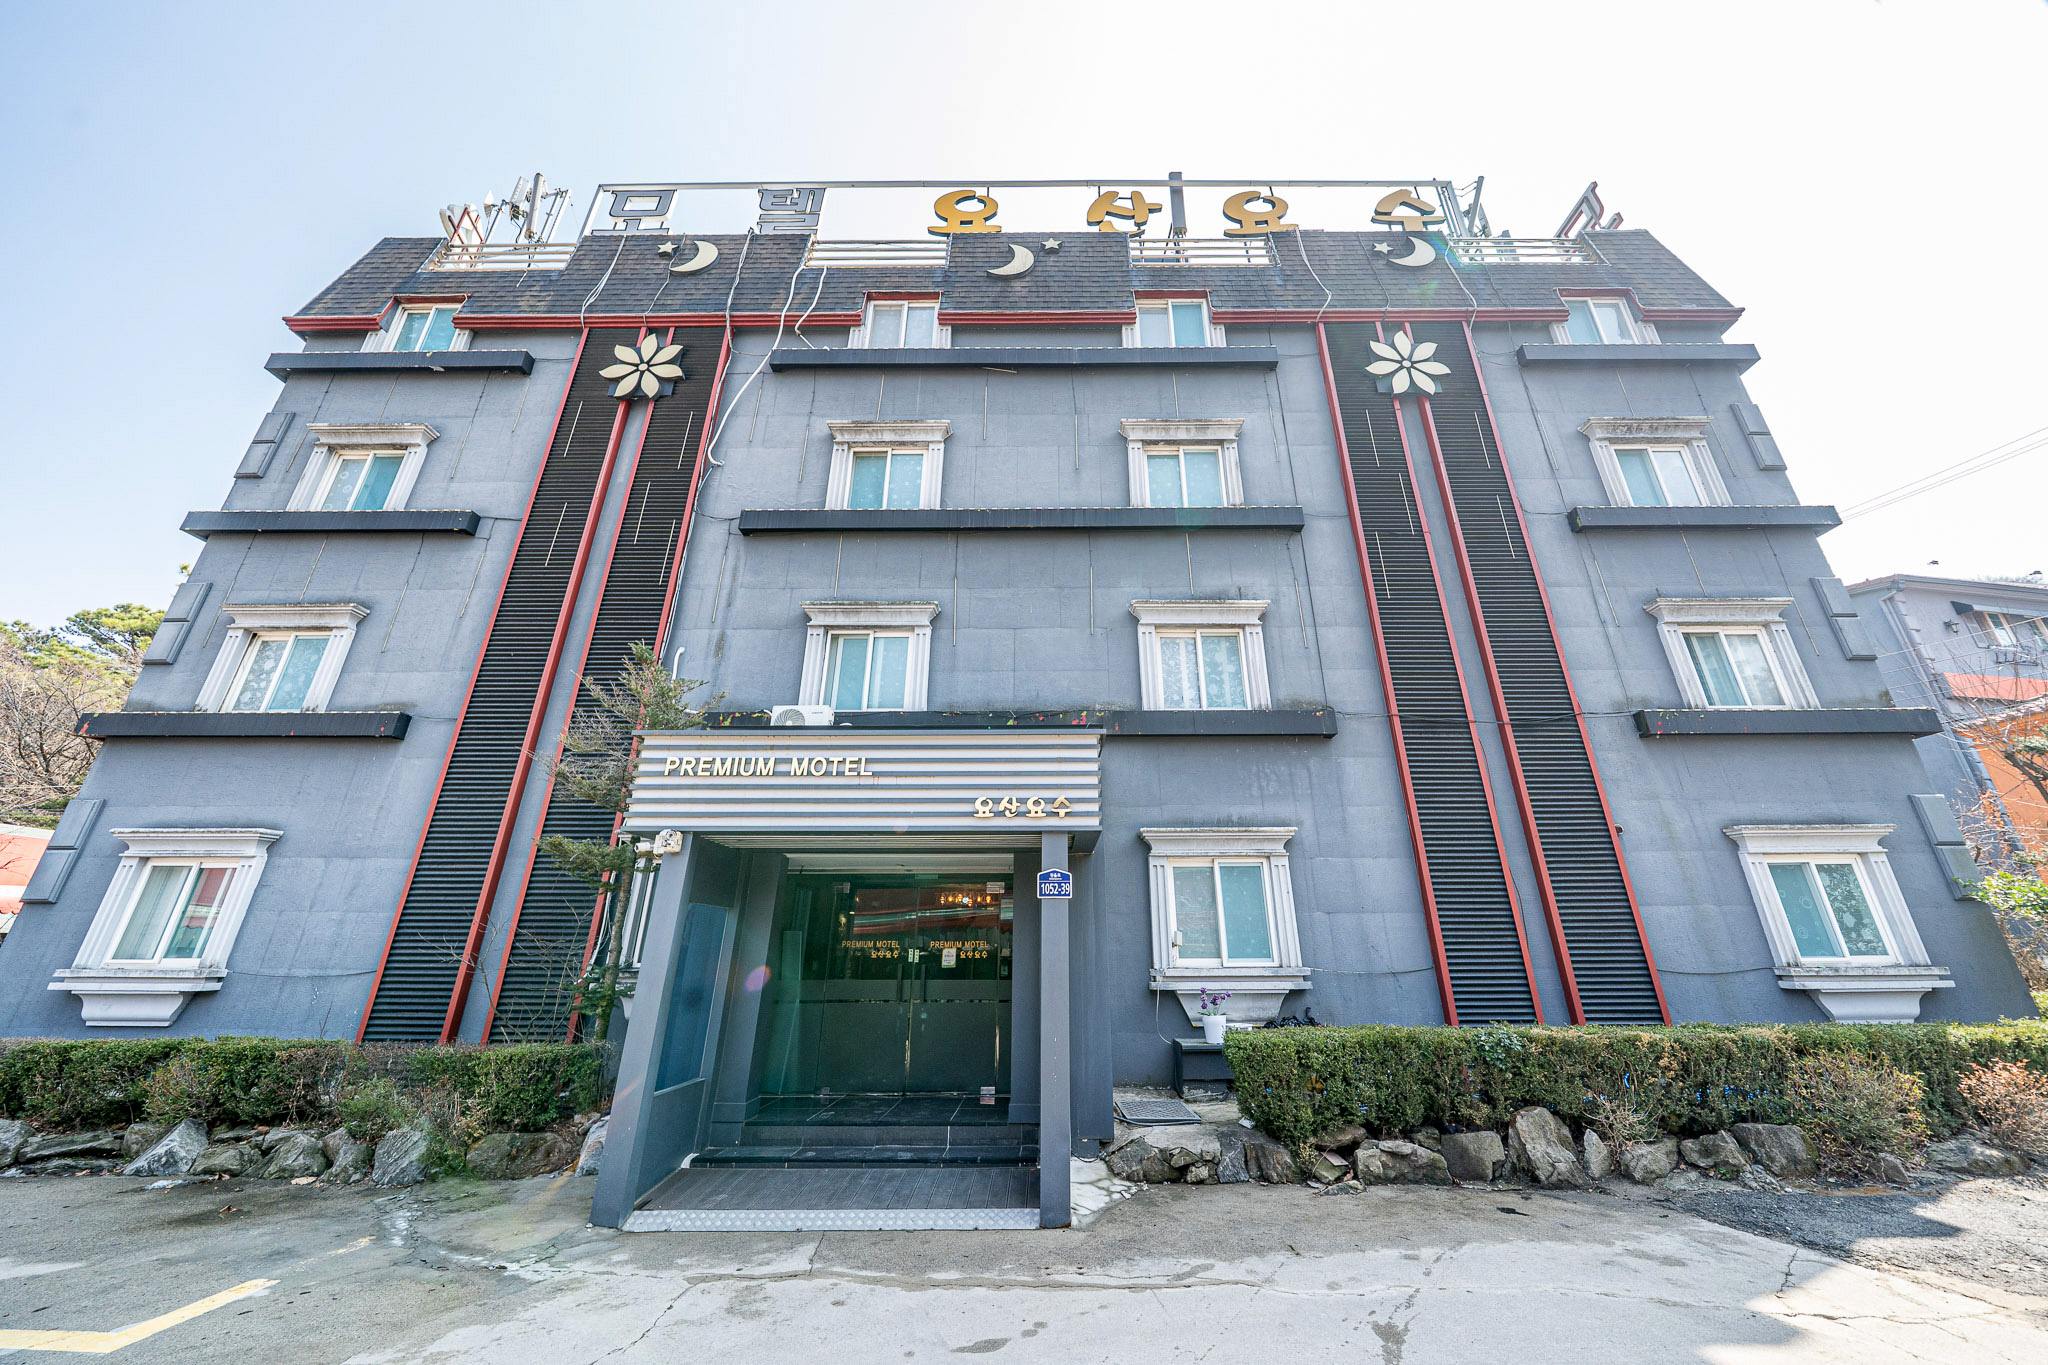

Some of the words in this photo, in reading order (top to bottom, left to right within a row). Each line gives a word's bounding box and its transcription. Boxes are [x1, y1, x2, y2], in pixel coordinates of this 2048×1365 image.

[591, 188, 827, 235] 모텔
[927, 189, 1447, 238] 요산요수
[664, 756, 776, 777] PREMIUM
[790, 756, 874, 777] MOTEL
[973, 795, 1073, 818] 요산요수
[1040, 882, 1070, 895] 1052-39
[841, 940, 874, 948] PREMIUM
[876, 940, 900, 948] MOTEL
[930, 940, 962, 948] PREMIUM
[964, 940, 989, 948] MOTEL
[871, 950, 899, 959] 요산요수
[960, 950, 988, 959] 요산요수
